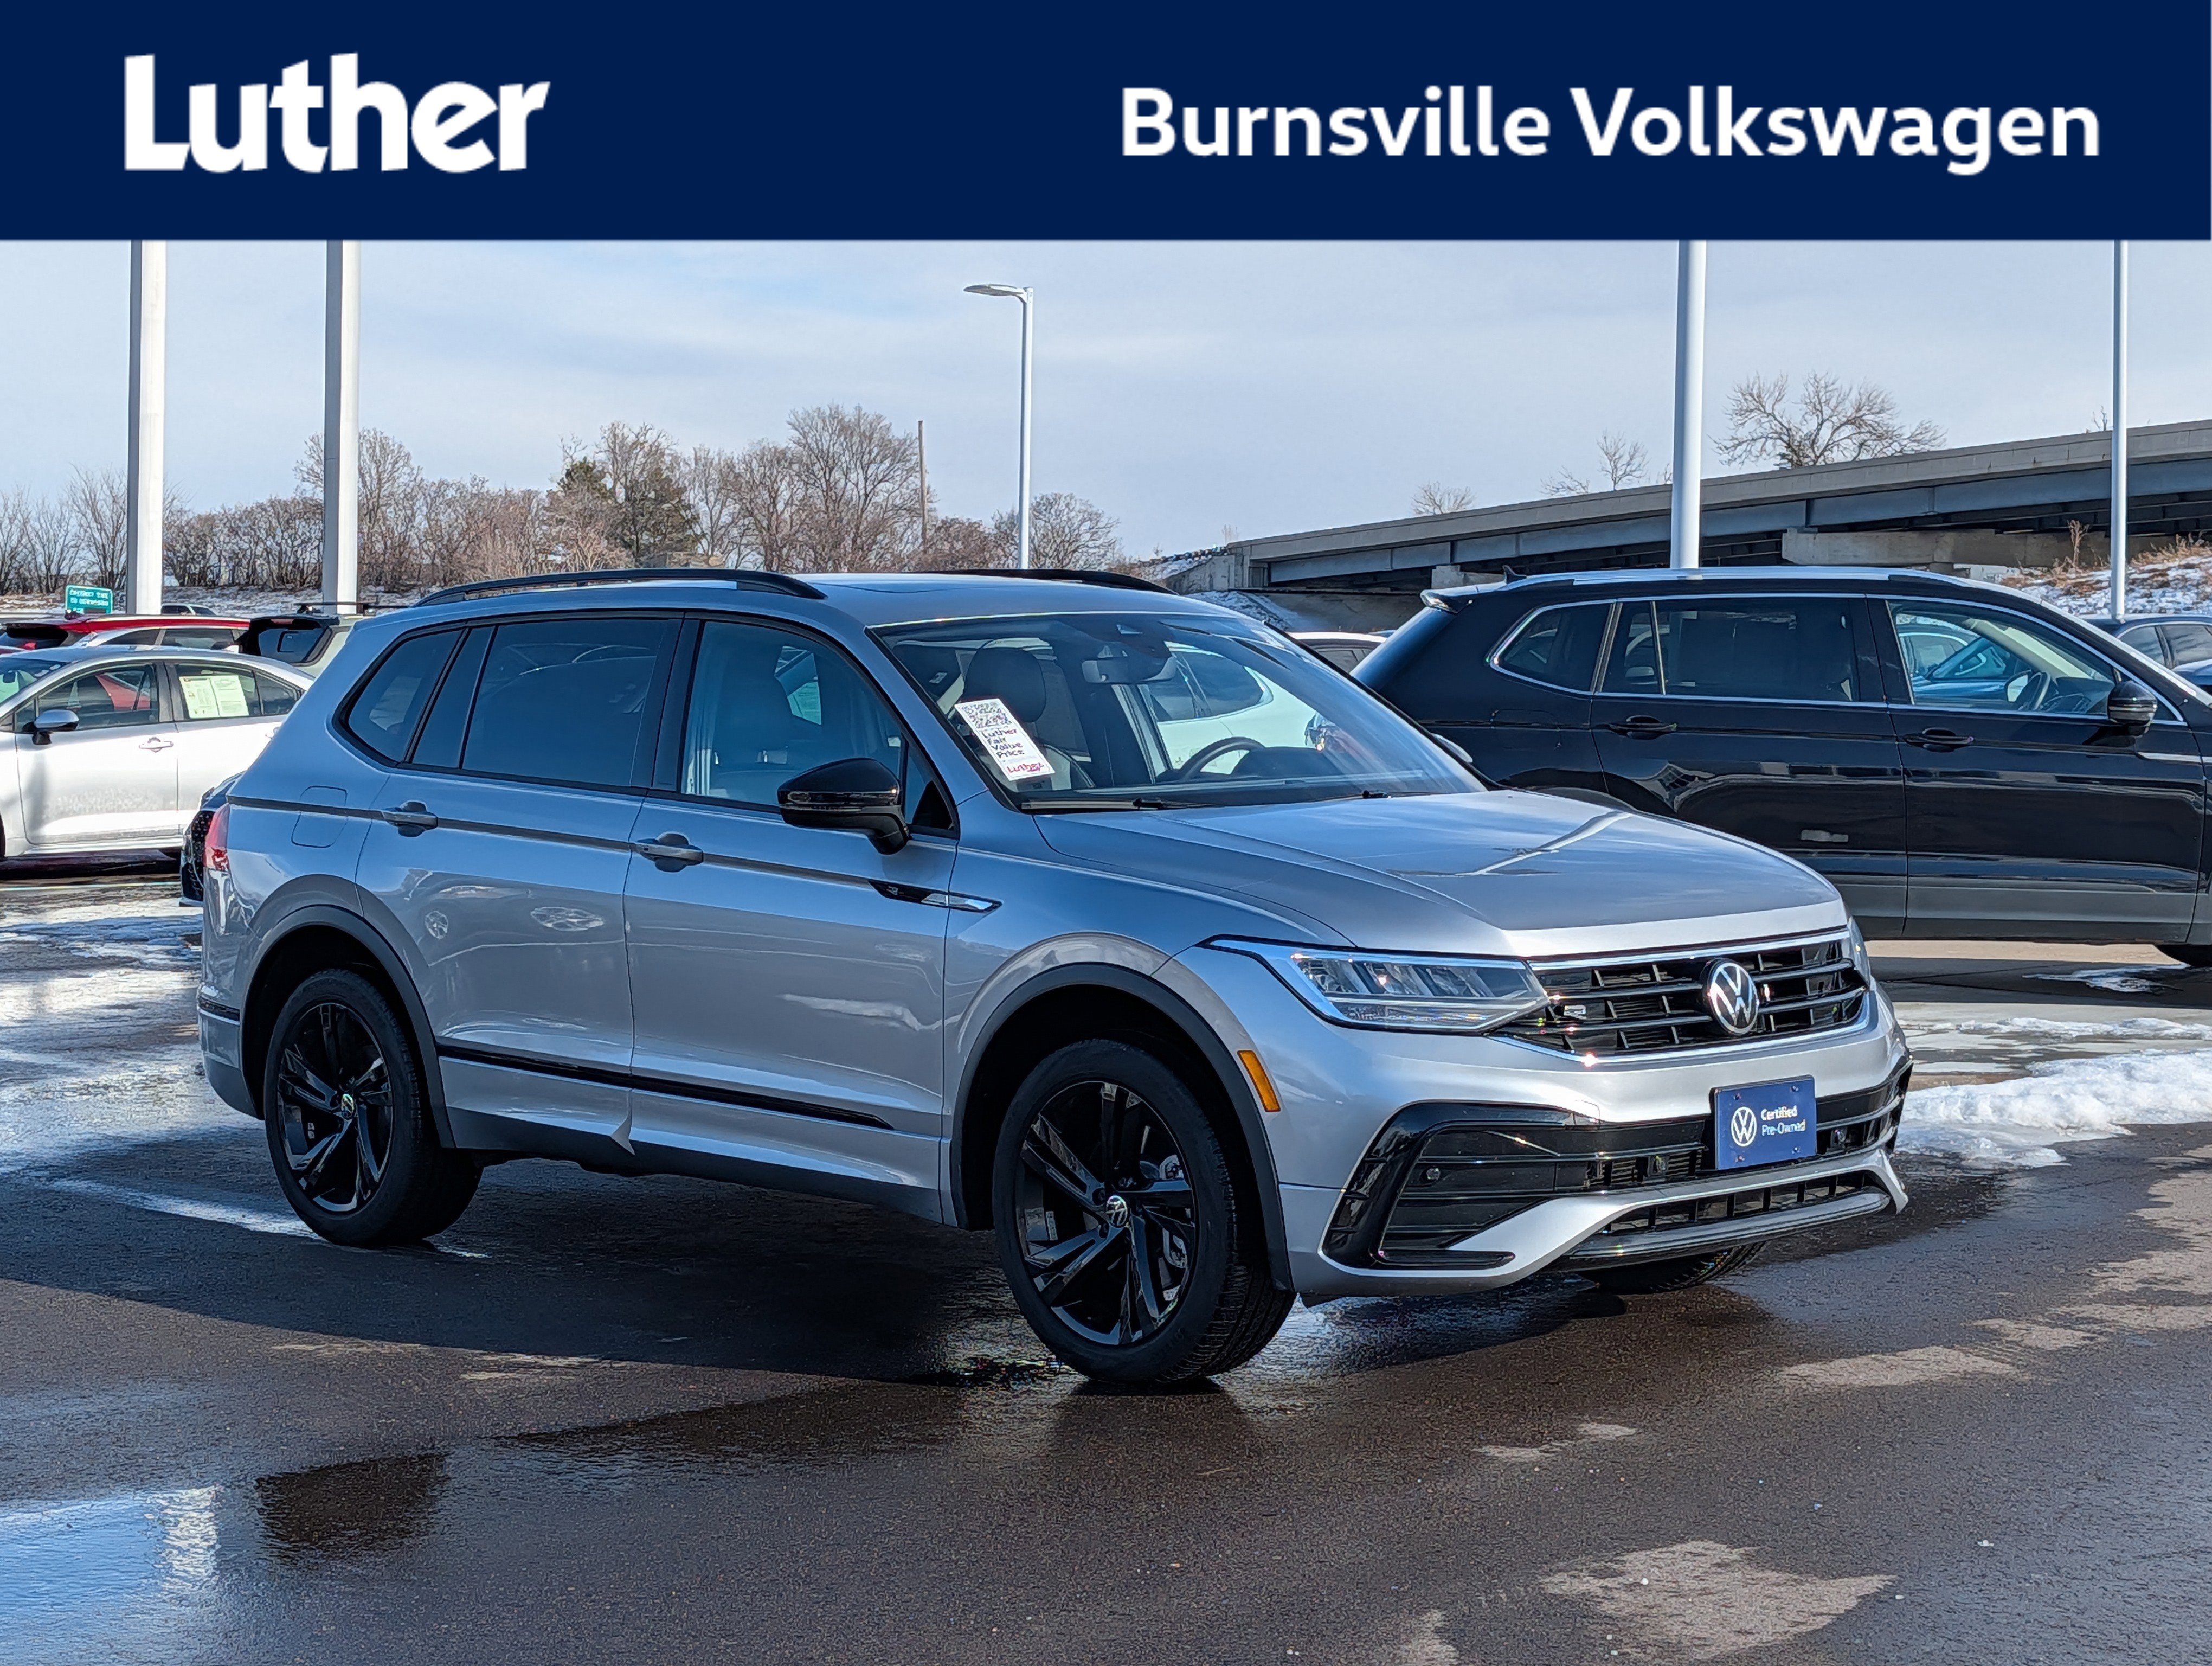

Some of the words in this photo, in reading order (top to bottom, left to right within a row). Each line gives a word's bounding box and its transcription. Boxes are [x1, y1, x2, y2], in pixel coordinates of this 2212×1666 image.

[982, 729, 1017, 739] Luther
[991, 742, 1023, 751] Value
[996, 749, 1025, 759] Price
[1006, 762, 1044, 773] Luther
[1761, 1105, 1798, 1120] Certified
[1761, 1118, 1806, 1136] Pre-Owned
